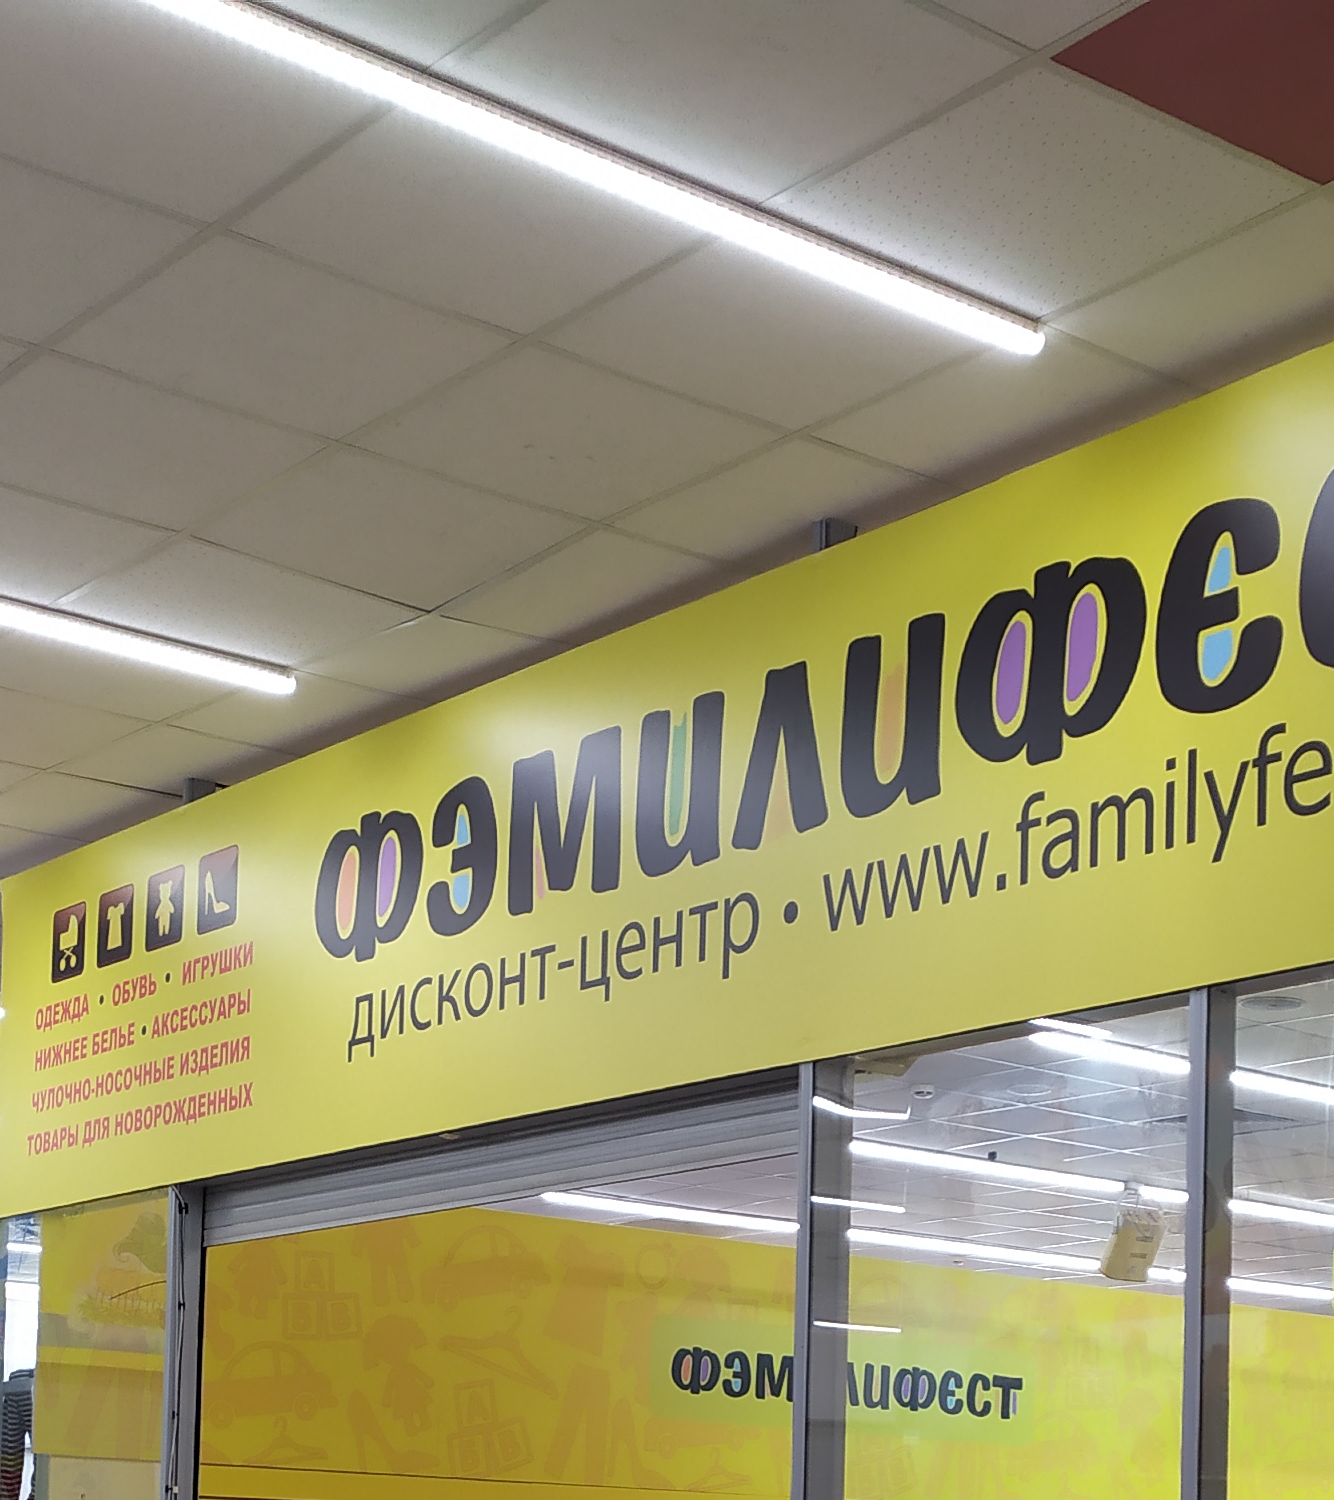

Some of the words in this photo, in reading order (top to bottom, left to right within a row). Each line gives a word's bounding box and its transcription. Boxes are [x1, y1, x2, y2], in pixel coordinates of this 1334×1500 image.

[36, 993, 90, 1031] ОДЕЖДА
[112, 972, 157, 1007] ОБУВЬ
[182, 941, 254, 986] ИГРУШКИ
[346, 895, 762, 1061] дисконт-центр
[34, 1037, 87, 1073] НИЖНЕЕ
[92, 1021, 136, 1057] БЕЛЬЕ
[151, 988, 252, 1040] АКСЕССУАРЫ
[32, 1055, 175, 1114] ЧУЛОЧНО-НОСОЧНЫЕ
[179, 1035, 251, 1077] ИЗДЕЛИЯ
[27, 1124, 79, 1157] ТОВАРЫ
[81, 1115, 110, 1148] ДЛЯ
[114, 1082, 254, 1137] НОВОРОЖДЕННЫХ
[671, 1346, 1023, 1420] ФЭМИФЕСТ
